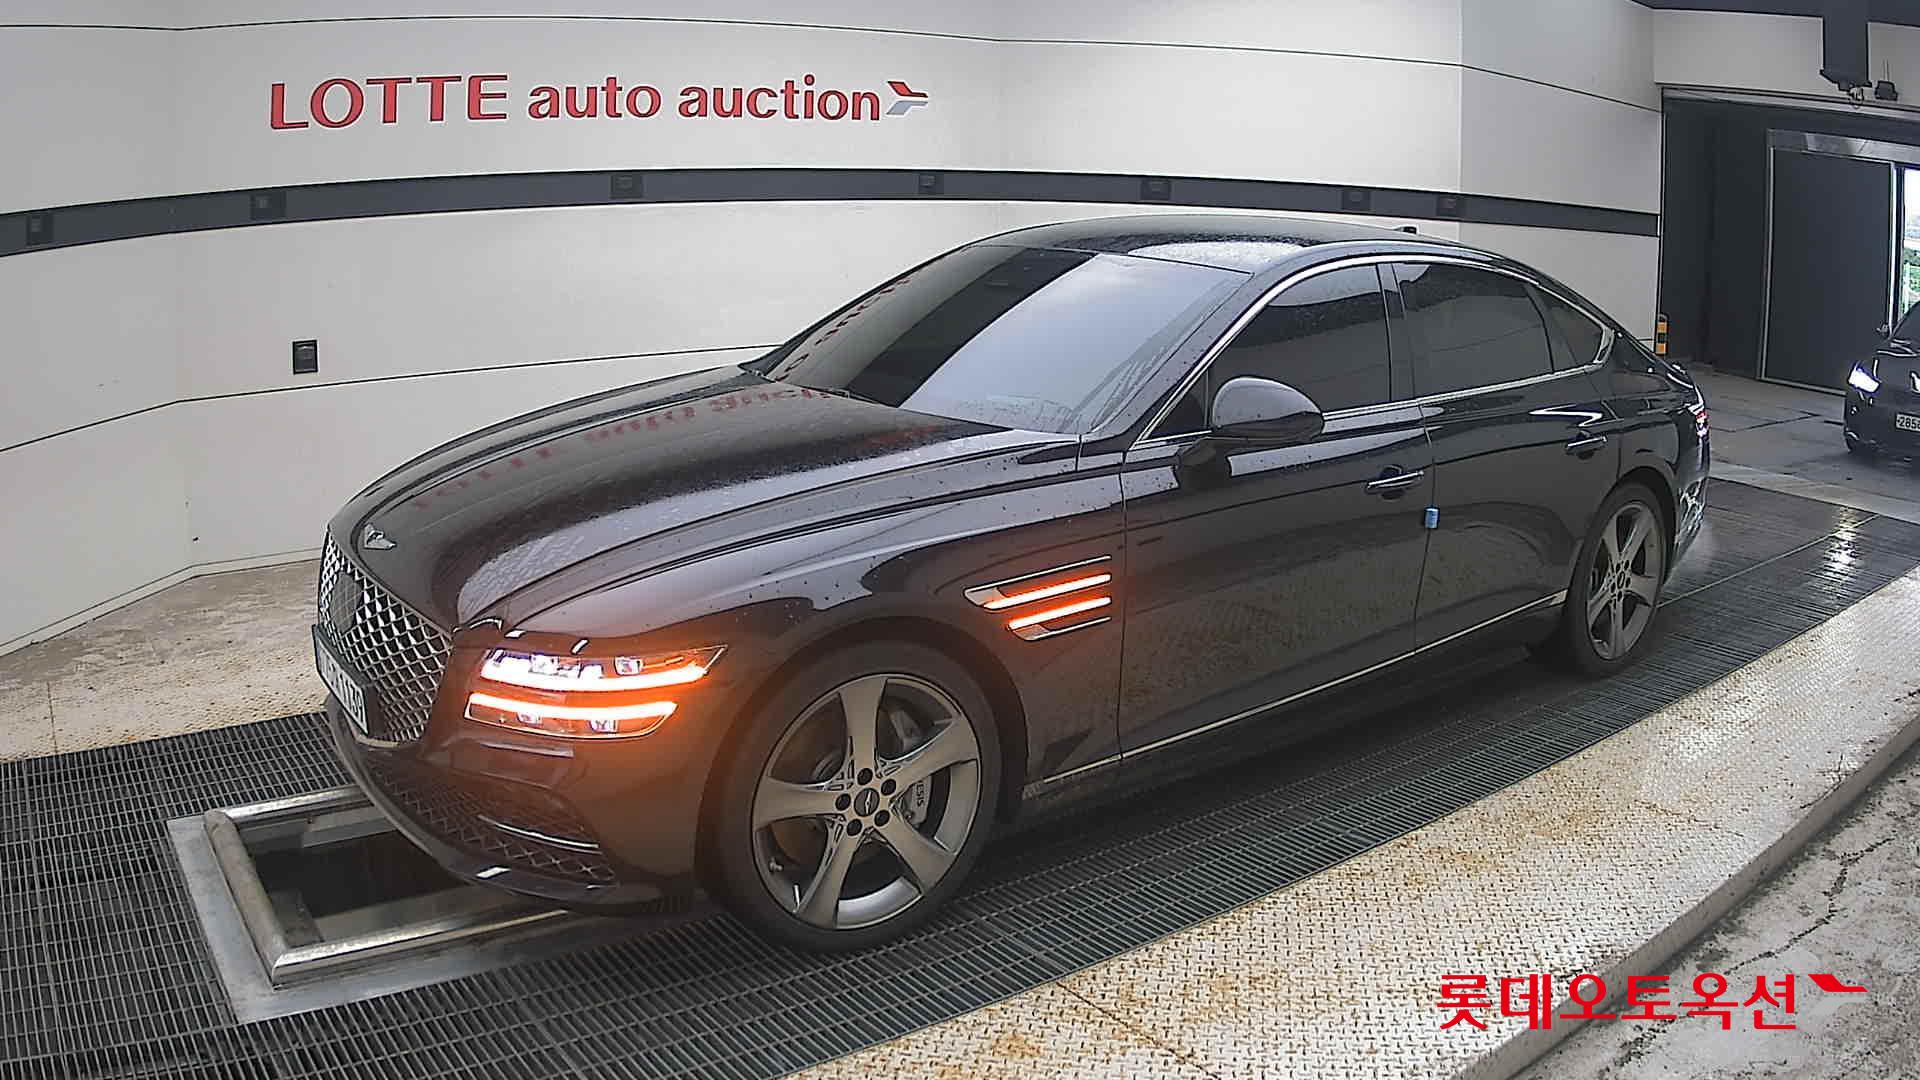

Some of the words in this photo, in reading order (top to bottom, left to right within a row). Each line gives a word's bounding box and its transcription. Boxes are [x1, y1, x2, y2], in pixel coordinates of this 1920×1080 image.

[270, 74, 508, 130] LOTTE
[527, 75, 662, 120] auto
[678, 74, 882, 122] auction
